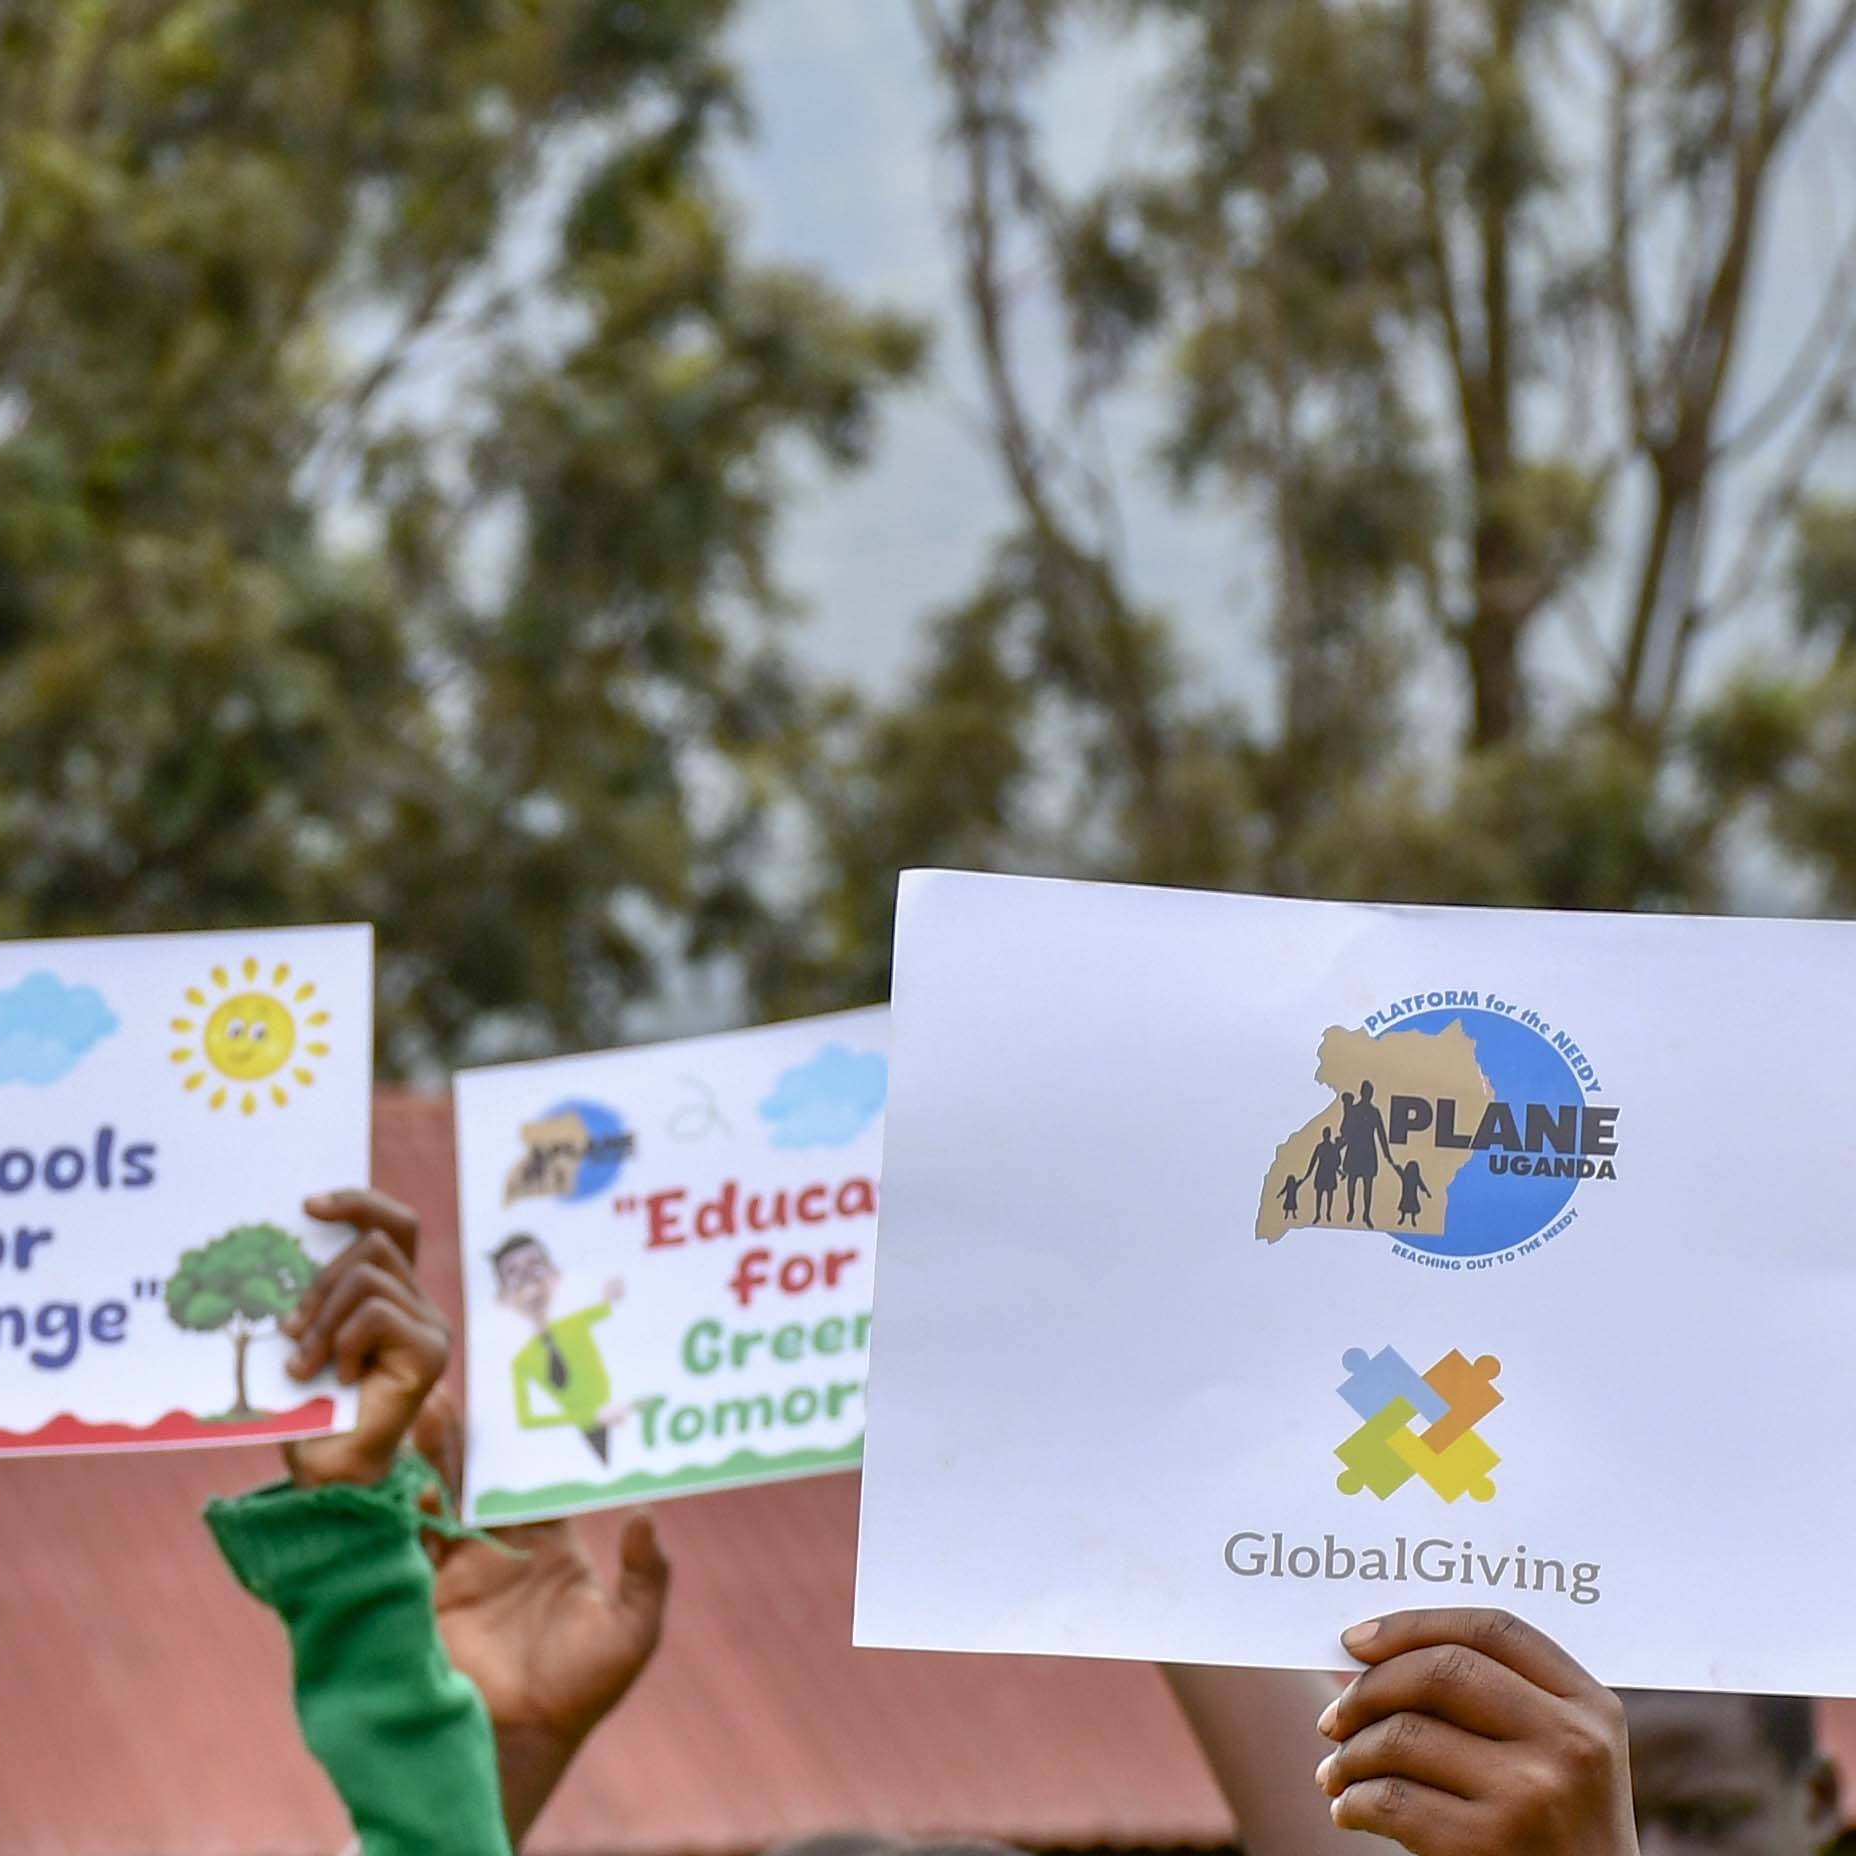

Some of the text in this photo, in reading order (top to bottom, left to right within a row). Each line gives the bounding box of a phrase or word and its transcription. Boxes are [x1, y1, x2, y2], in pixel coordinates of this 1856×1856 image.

[1364, 990, 1602, 1094] PLATFORM for the NEEDY
[1388, 1095, 1620, 1157] PLANE
[1488, 1154, 1617, 1181] UGANDA
[614, 1178, 877, 1249] "Educa
[1391, 1207, 1580, 1271] REACHING OUT TO THE NEEDY
[729, 1248, 858, 1307] for
[633, 1380, 868, 1448] Tomor
[1222, 1530, 1601, 1605] GlobalGiving
